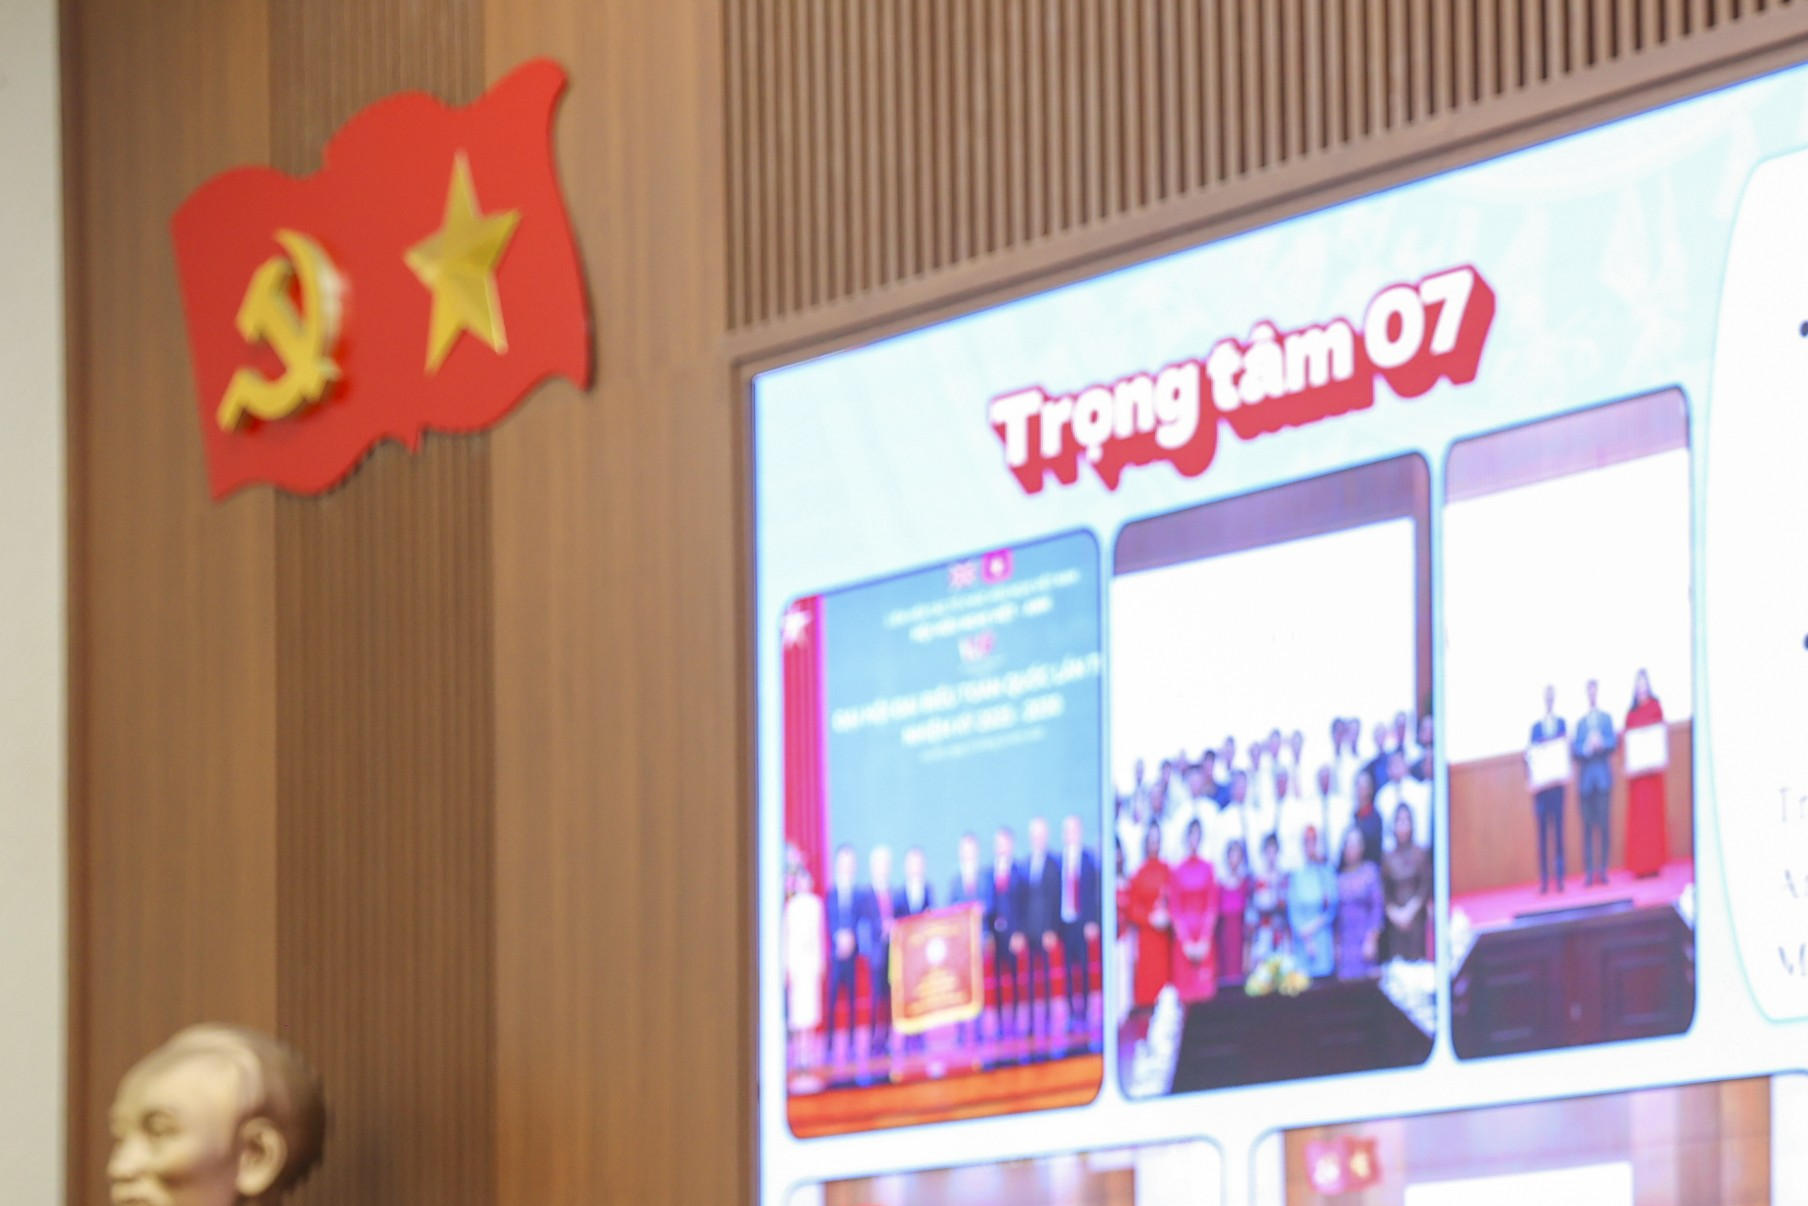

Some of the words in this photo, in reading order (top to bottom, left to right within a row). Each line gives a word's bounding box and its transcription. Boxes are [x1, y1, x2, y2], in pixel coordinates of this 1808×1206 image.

[988, 357, 1206, 470] Trọng
[1204, 320, 1358, 415] tâm
[1364, 267, 1478, 370] 07
